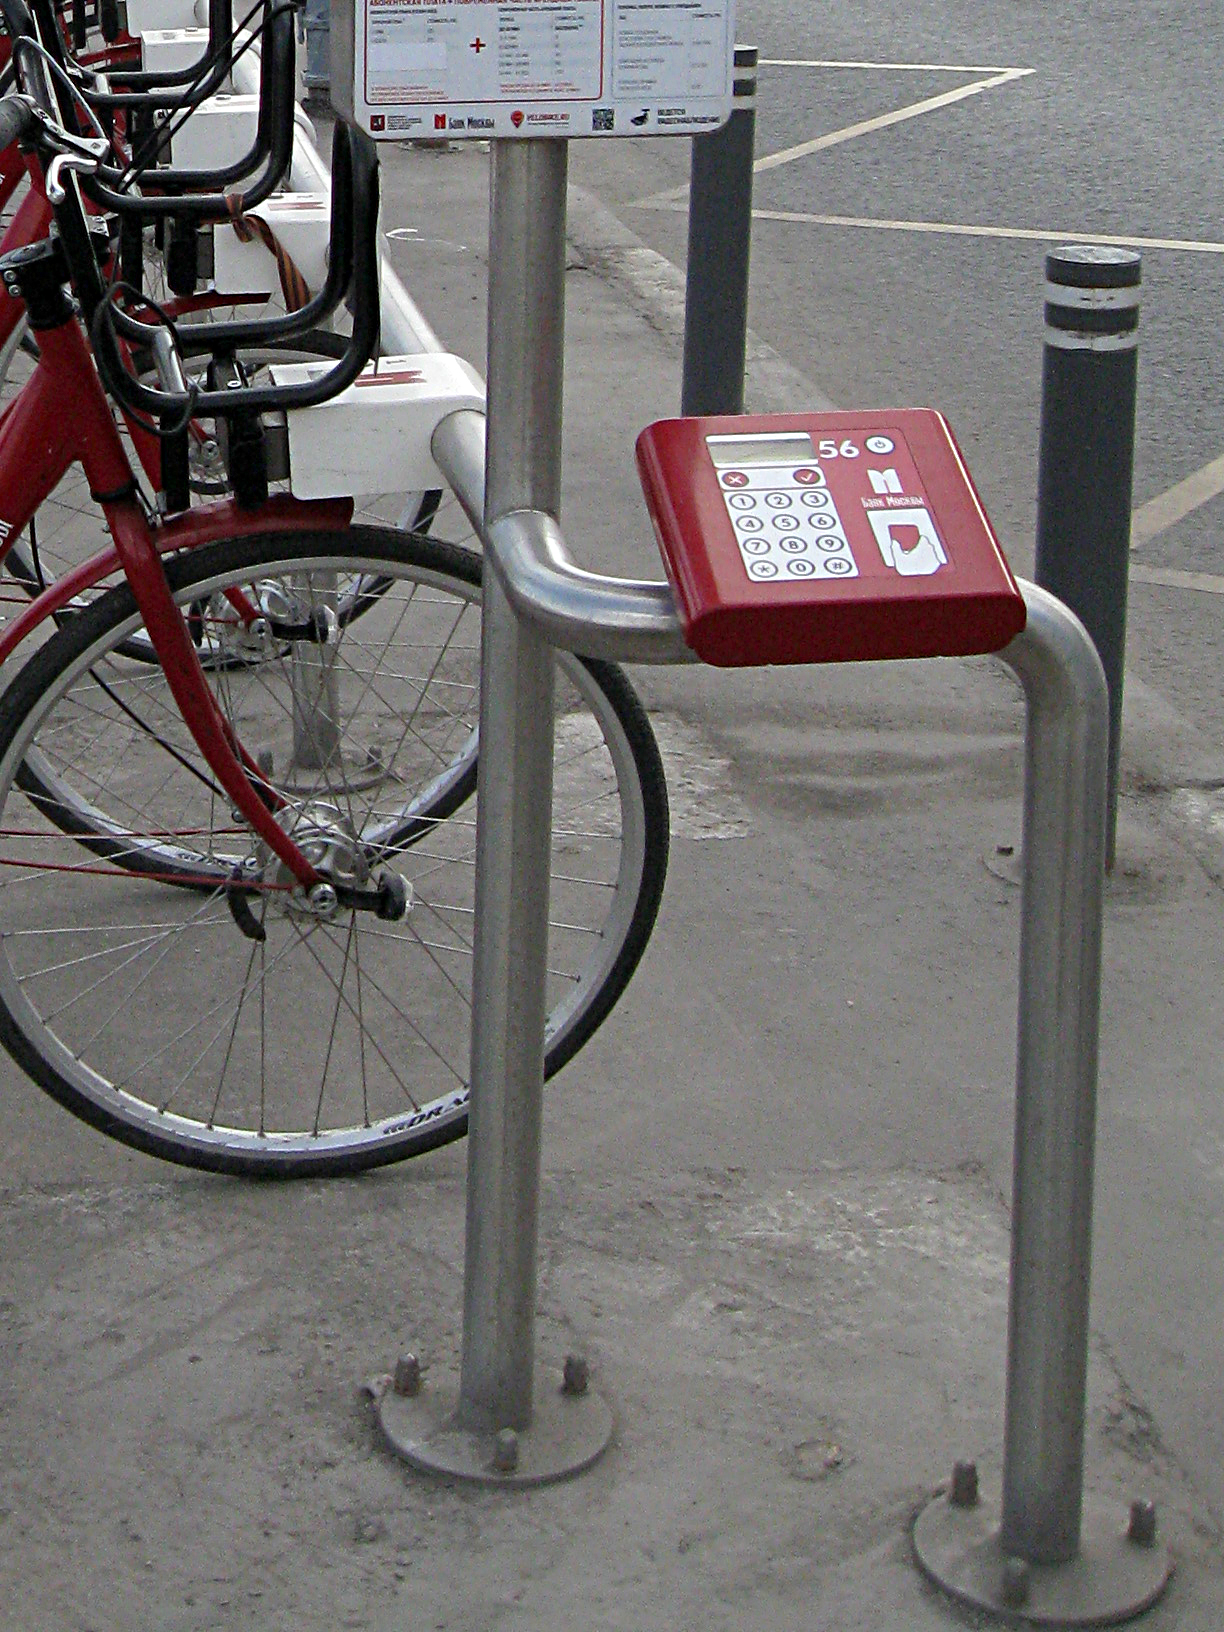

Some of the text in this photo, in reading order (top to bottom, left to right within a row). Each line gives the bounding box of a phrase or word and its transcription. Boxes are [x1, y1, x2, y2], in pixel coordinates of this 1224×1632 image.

[819, 439, 860, 459] 56
[739, 494, 820, 507] 1 2 3
[744, 516, 828, 529] 4 5 6
[750, 539, 835, 552] 7 8 9
